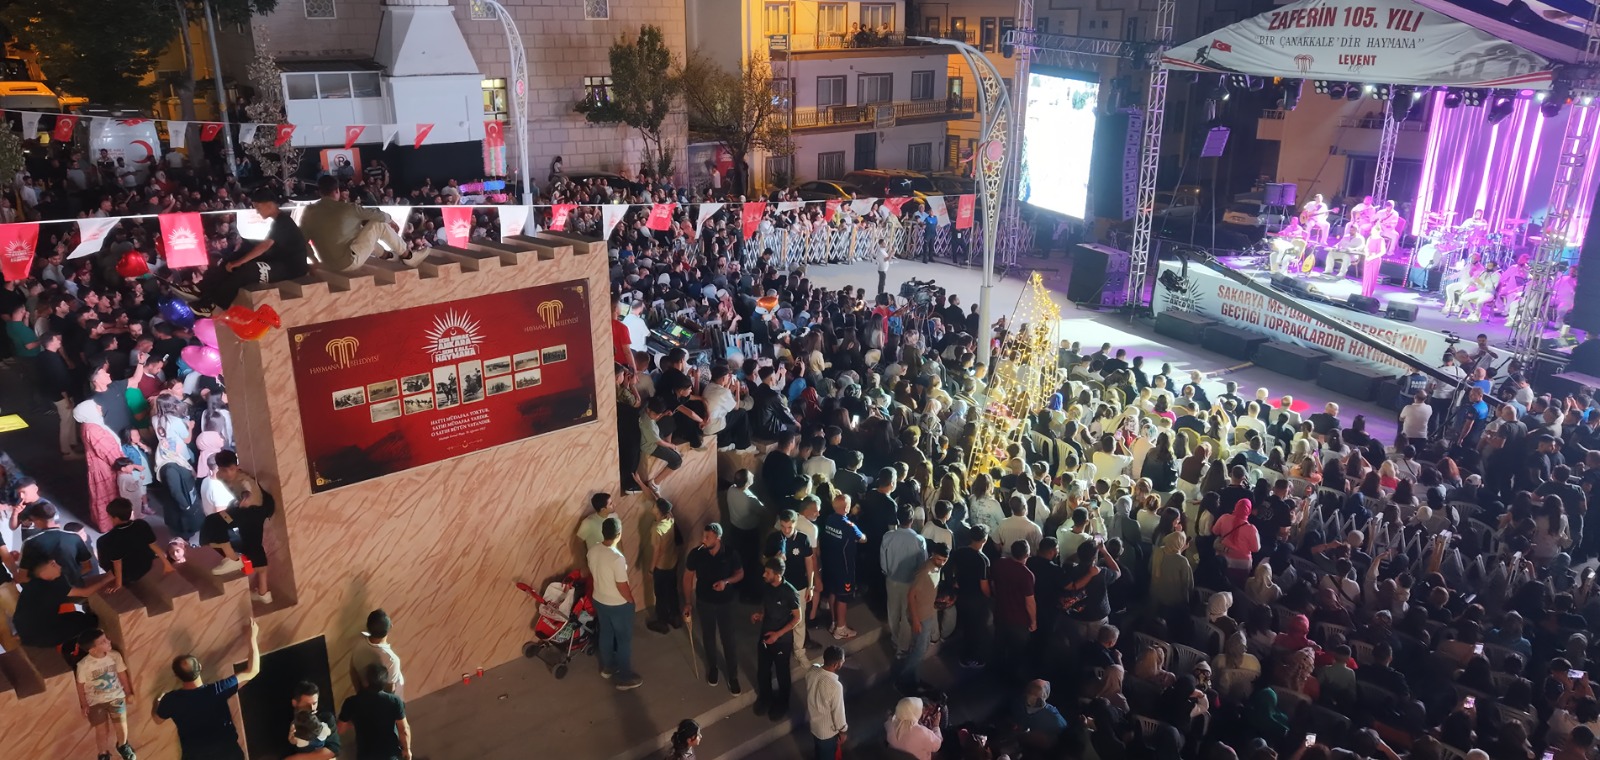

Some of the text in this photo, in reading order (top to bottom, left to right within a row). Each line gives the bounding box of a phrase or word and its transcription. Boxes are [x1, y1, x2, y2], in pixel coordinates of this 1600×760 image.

[1268, 3, 1425, 33] ZAFERİN 105. YILI
[1338, 54, 1377, 66] LEVENT
[1217, 284, 1264, 310] SAKARYA
[1263, 313, 1347, 352] TOPRAKLARDIR
[438, 337, 472, 350] ANKARA
[435, 348, 476, 362] HAYMANA
[309, 363, 341, 375] HAYMANA
